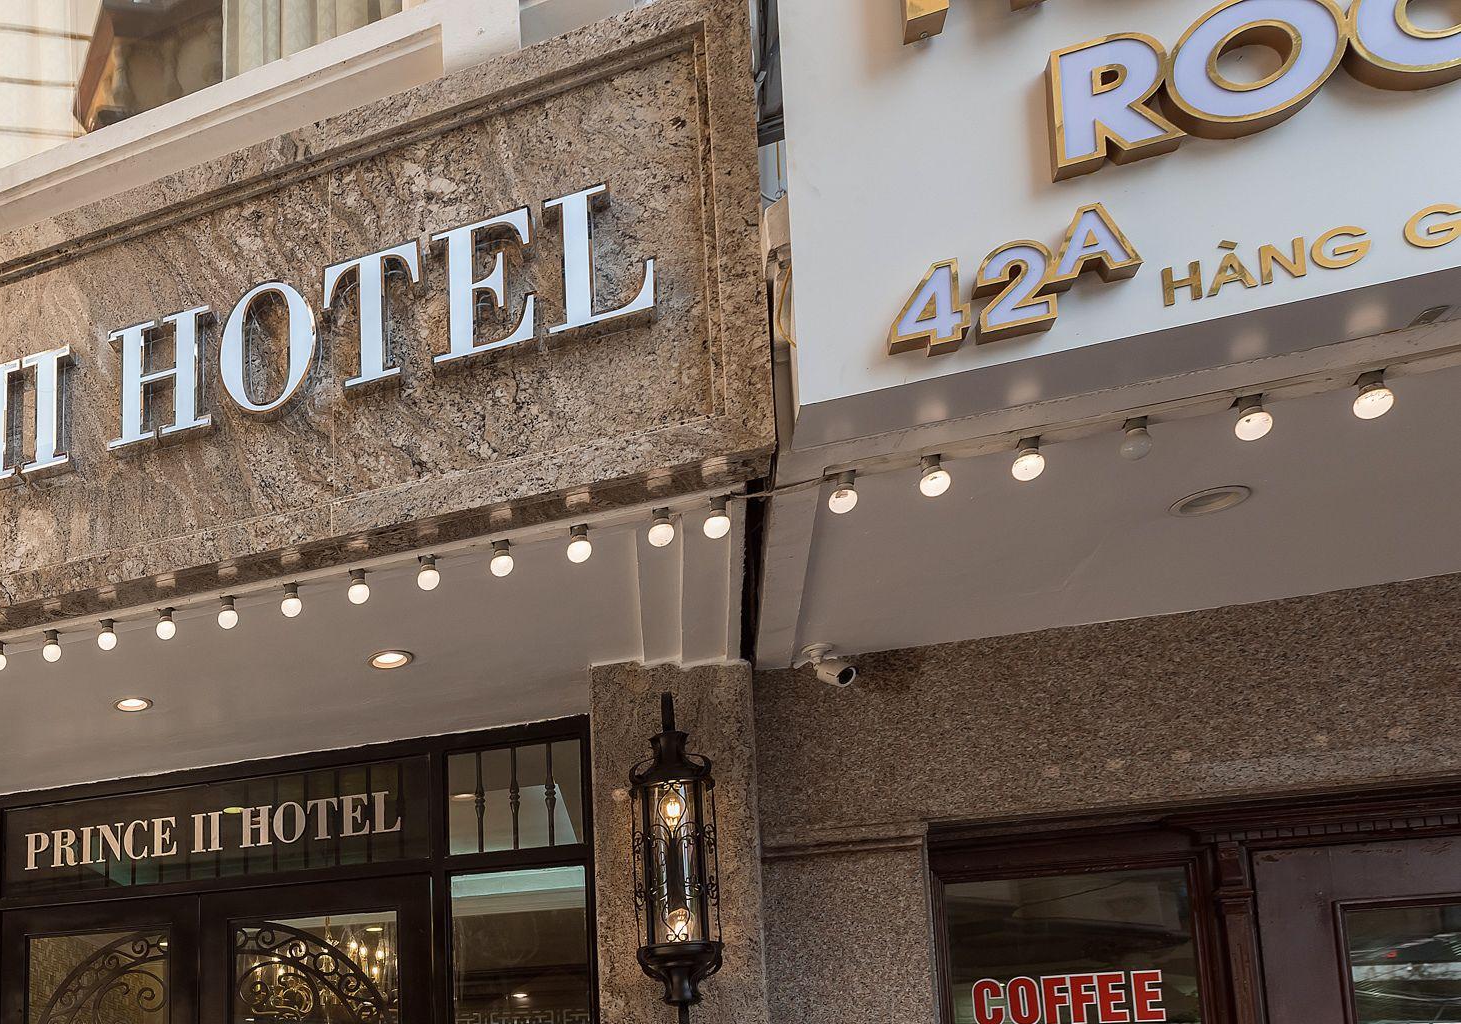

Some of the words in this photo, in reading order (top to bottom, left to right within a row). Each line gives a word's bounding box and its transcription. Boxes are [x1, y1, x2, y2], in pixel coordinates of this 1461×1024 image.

[106, 184, 656, 450] HOTEL
[887, 202, 1144, 358] 42A
[1161, 225, 1372, 308] HÀNG
[24, 815, 177, 871] PRINCE
[190, 811, 225, 855] II
[238, 790, 402, 848] HOTEL
